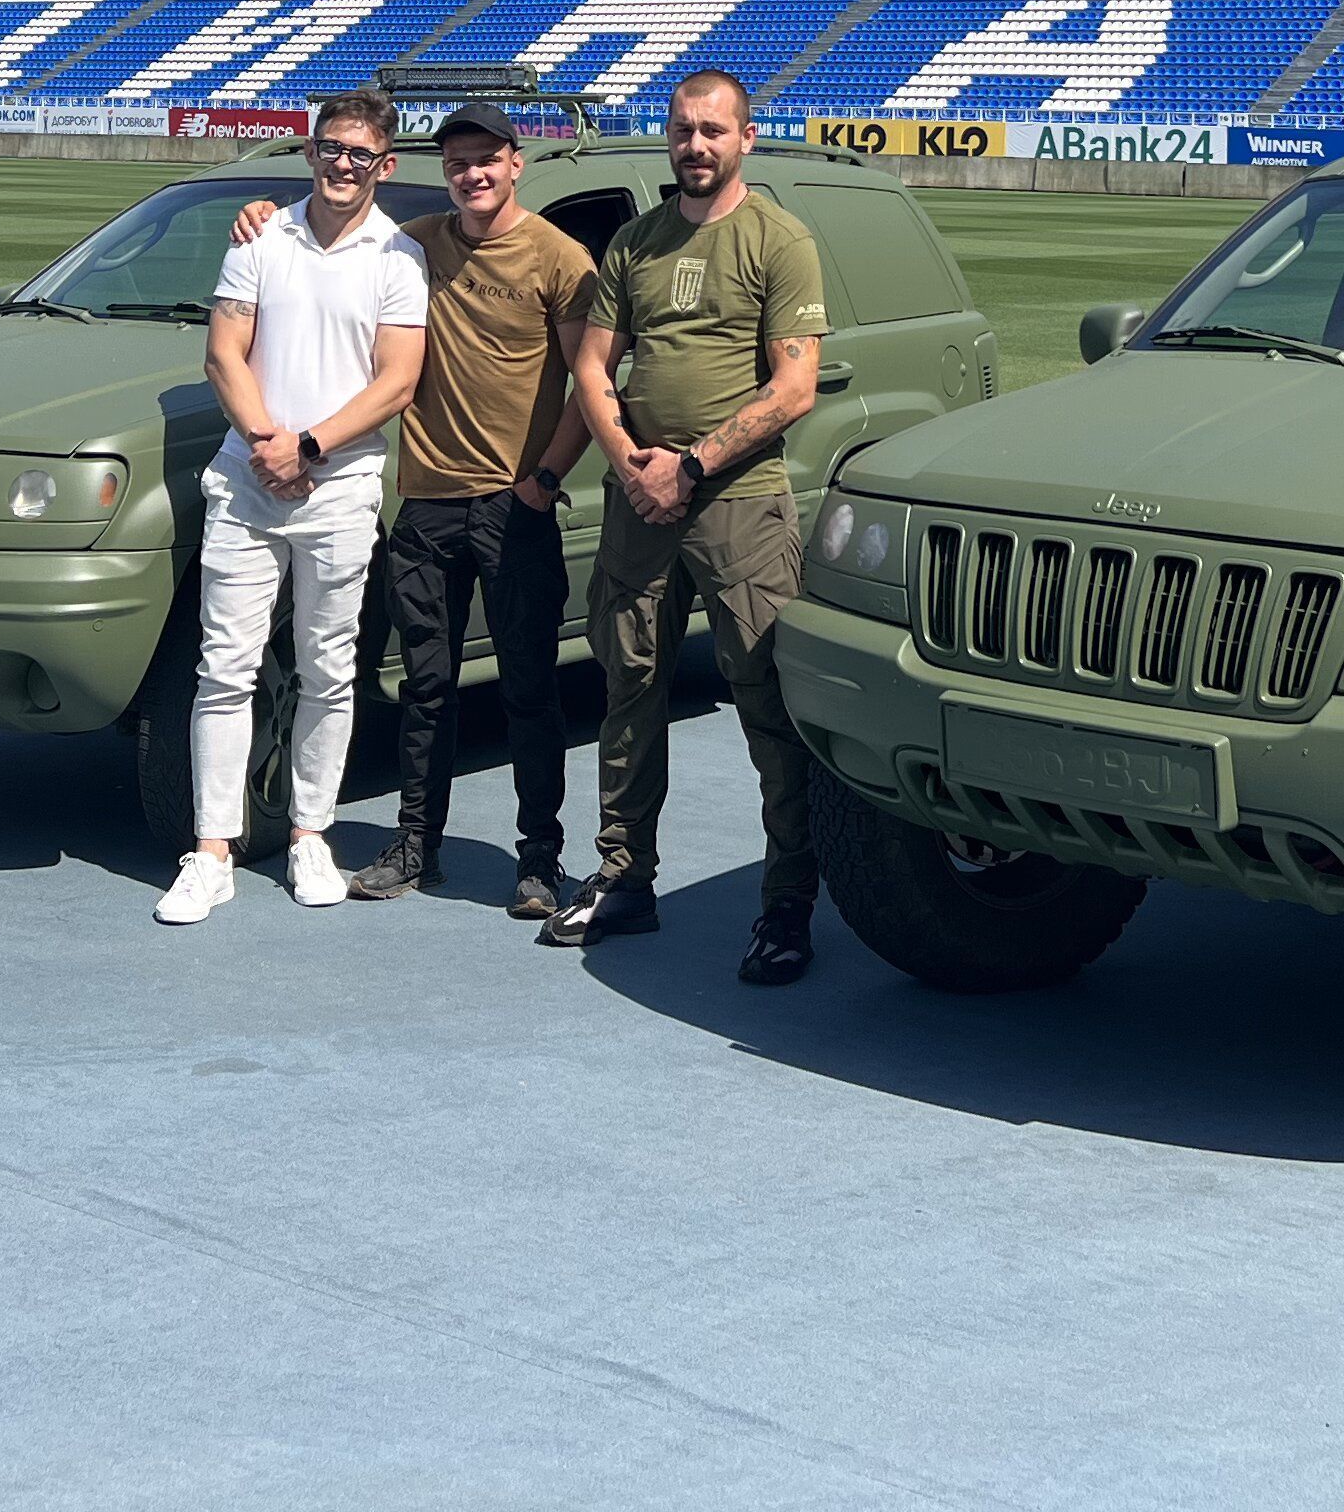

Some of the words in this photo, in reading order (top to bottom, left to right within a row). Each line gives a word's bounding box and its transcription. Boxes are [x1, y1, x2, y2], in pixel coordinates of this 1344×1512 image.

[51, 116, 98, 127] ДОБРОБУТ
[115, 117, 165, 129] DOBROBUT
[209, 123, 235, 137] new
[238, 122, 294, 138] balance
[820, 123, 887, 154] KLO
[918, 125, 988, 157] KLO
[1034, 125, 1214, 164] ABank24
[1246, 132, 1325, 157] WINNER
[1251, 156, 1308, 167] AUTOMOTIVE
[478, 284, 525, 302] ROCKS
[1091, 492, 1161, 524] Jeep
